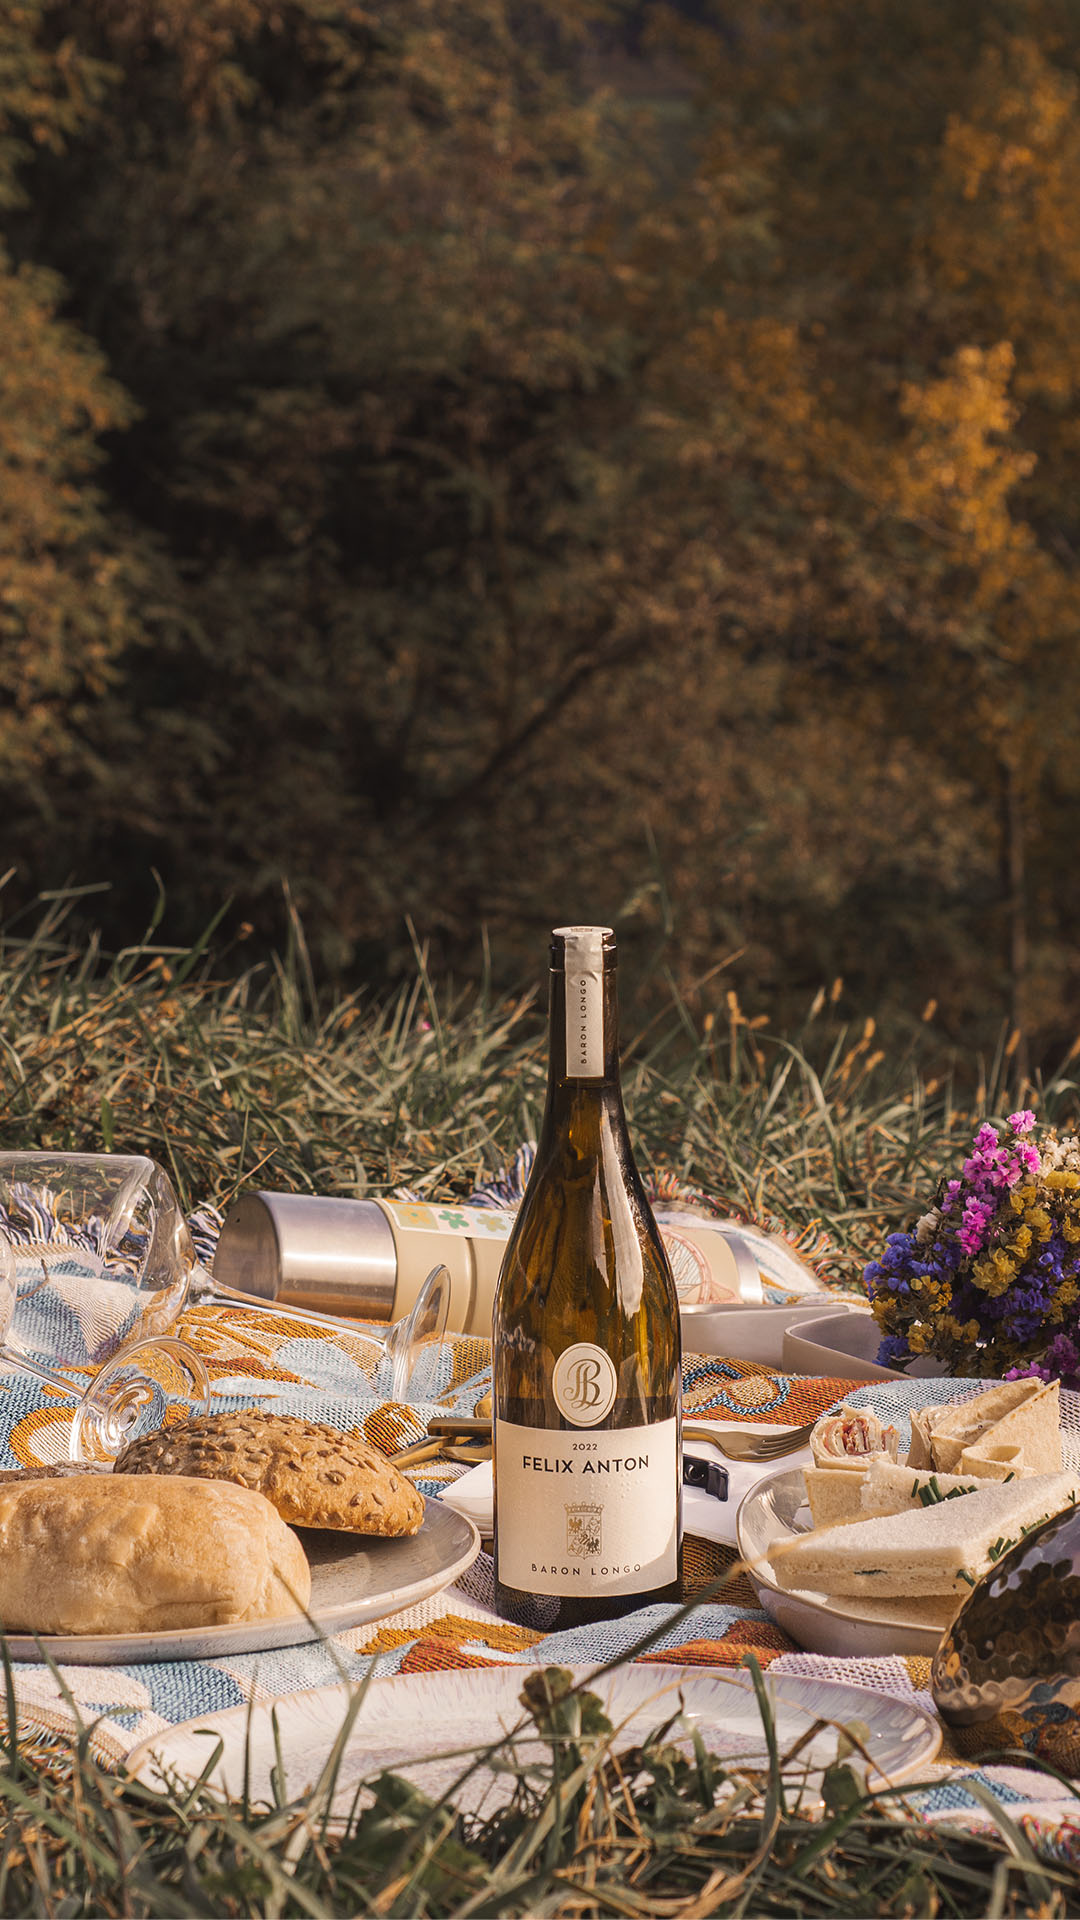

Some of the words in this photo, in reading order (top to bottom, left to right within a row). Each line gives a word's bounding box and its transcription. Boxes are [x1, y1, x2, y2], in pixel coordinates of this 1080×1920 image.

[572, 1443, 598, 1451] 2022
[523, 1455, 574, 1474] FELIX
[582, 1455, 649, 1474] ANTON
[531, 1563, 580, 1576] BARON
[591, 1563, 641, 1576] LONGO
